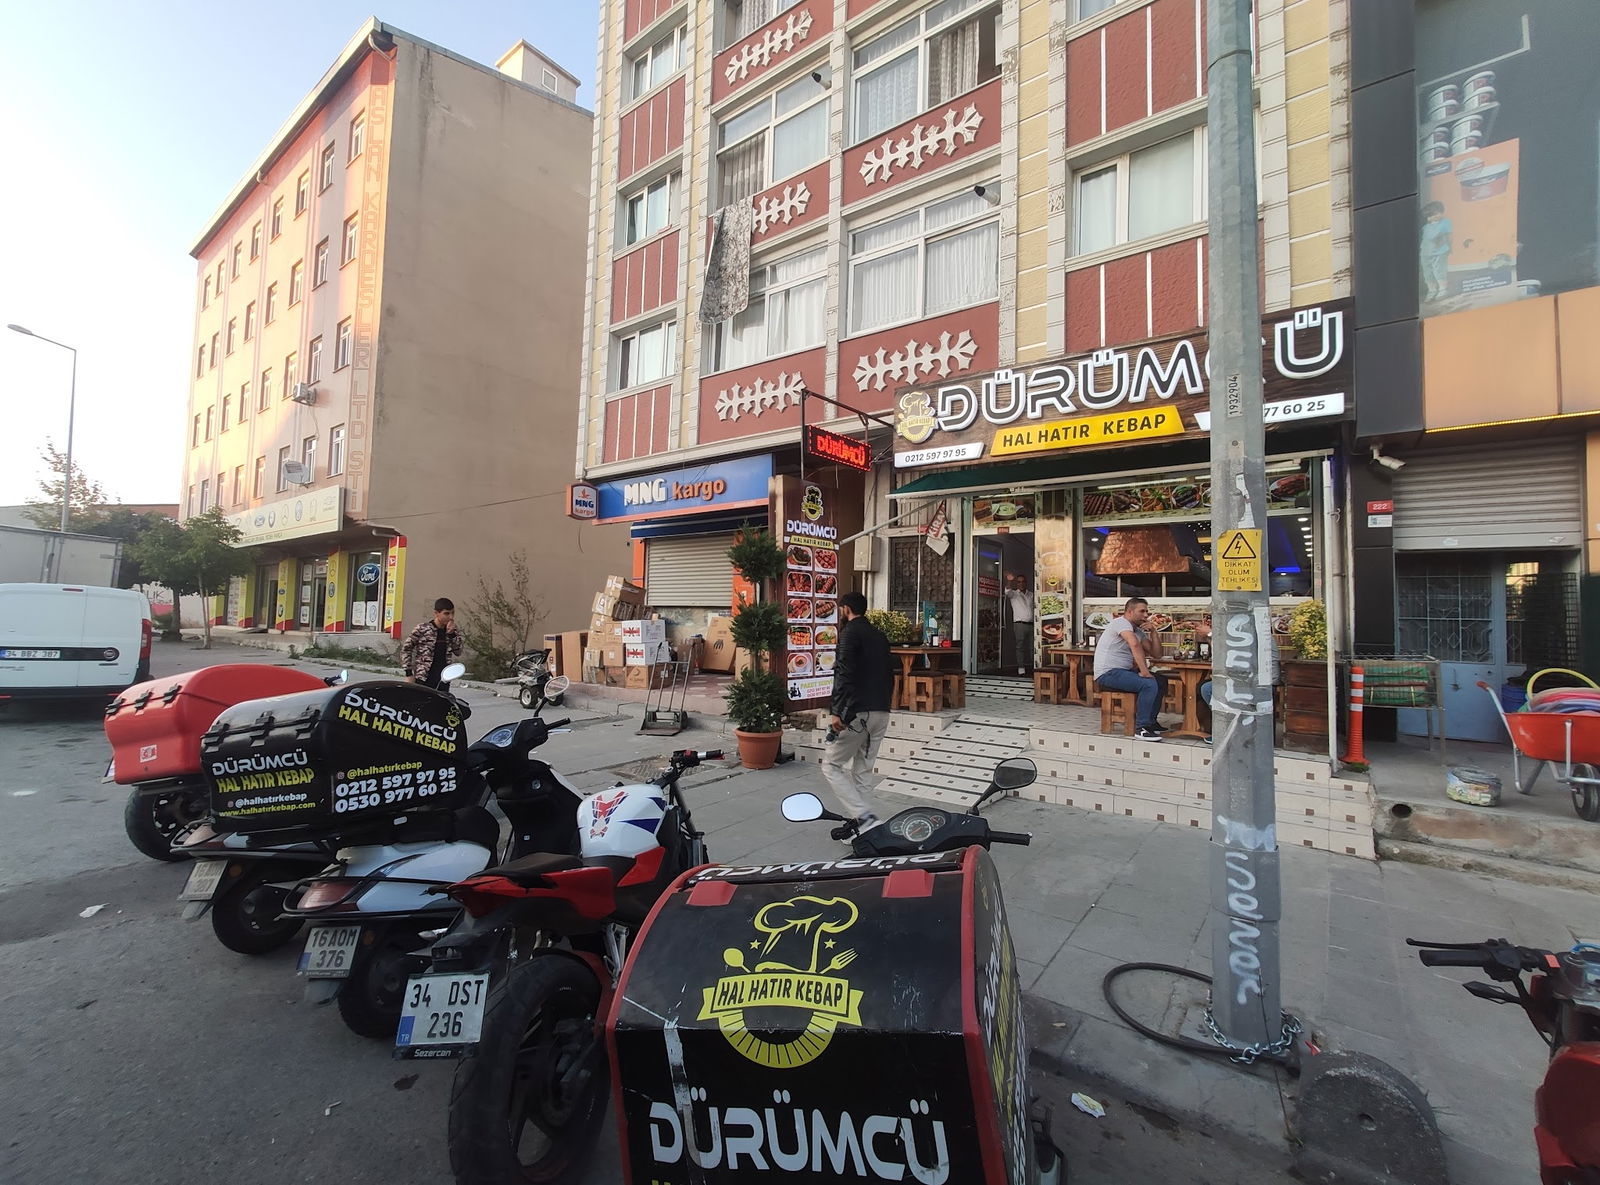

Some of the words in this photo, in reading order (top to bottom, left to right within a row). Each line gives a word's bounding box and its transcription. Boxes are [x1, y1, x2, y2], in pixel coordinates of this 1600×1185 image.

[366, 87, 387, 182] ASLAN
[937, 306, 1343, 432] DÜRÜMÜ
[351, 380, 367, 440] LTD
[1228, 376, 1239, 415] 1932904
[1264, 406, 1279, 418] 77
[1282, 403, 1303, 415] 60
[1306, 400, 1325, 412] 25
[1002, 431, 1033, 447] HAL
[1037, 424, 1090, 443] HATIR
[1103, 413, 1166, 435] KEBAP
[905, 453, 924, 463] 0212
[926, 451, 940, 460] 597
[942, 450, 953, 459] 97
[955, 448, 966, 457] 95
[575, 499, 594, 509] MNG
[623, 478, 668, 507] MNG
[672, 477, 727, 502] kargo
[575, 508, 594, 516] kargo
[344, 687, 457, 741] DÜRÜMCÜ
[338, 704, 369, 727] HAL
[372, 716, 414, 741] HATIR
[415, 731, 456, 754] KEBAP
[212, 748, 308, 776] DÜRÜMCÜ
[216, 776, 241, 793] HAL
[240, 772, 276, 790] HATIR
[276, 768, 315, 786] KEBAP
[335, 778, 378, 797] 0212
[382, 773, 412, 790] 597
[416, 770, 435, 784] 97
[438, 767, 456, 780] 95
[335, 792, 381, 813] 0530
[384, 786, 415, 804] 977
[418, 783, 438, 797] 60
[440, 780, 457, 793] 25
[316, 949, 346, 968] 376
[410, 983, 431, 1008] 34
[448, 979, 484, 1006] DST
[719, 981, 744, 1006] HAL
[748, 978, 792, 1002] HATIR
[796, 979, 843, 1006] KEBAP
[401, 1034, 409, 1042] TR
[427, 1011, 463, 1038] 236
[414, 1048, 452, 1057] Sezercan
[649, 1086, 950, 1185] DÜRÜMCÜ
